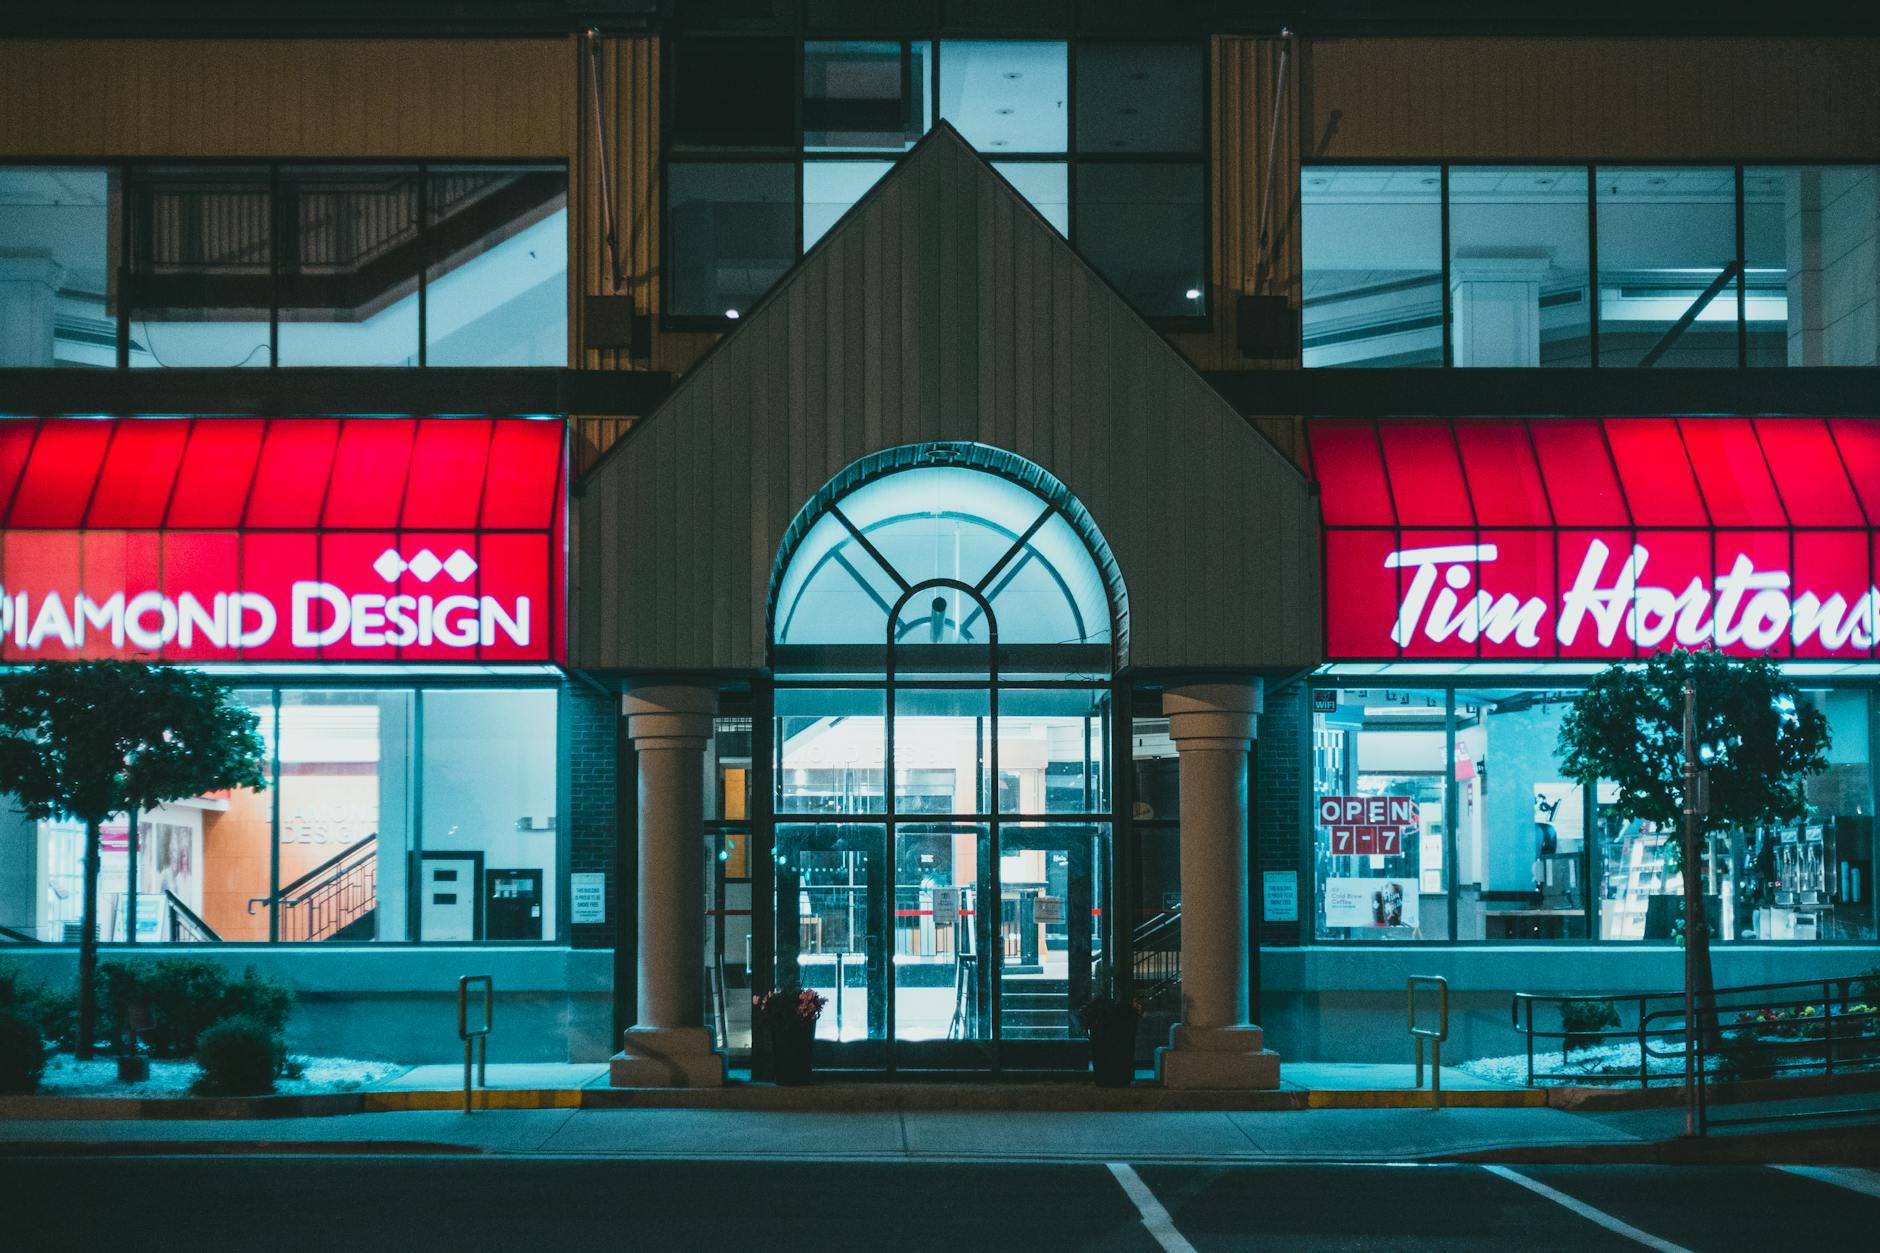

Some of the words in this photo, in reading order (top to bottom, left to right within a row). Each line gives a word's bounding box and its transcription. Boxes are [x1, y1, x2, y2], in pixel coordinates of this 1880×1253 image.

[0, 585, 277, 649] IAMOND
[291, 581, 530, 648] DESIGN
[1384, 543, 1547, 648] Tim
[1556, 538, 1880, 649] Hortons
[1321, 801, 1408, 822] OPEN
